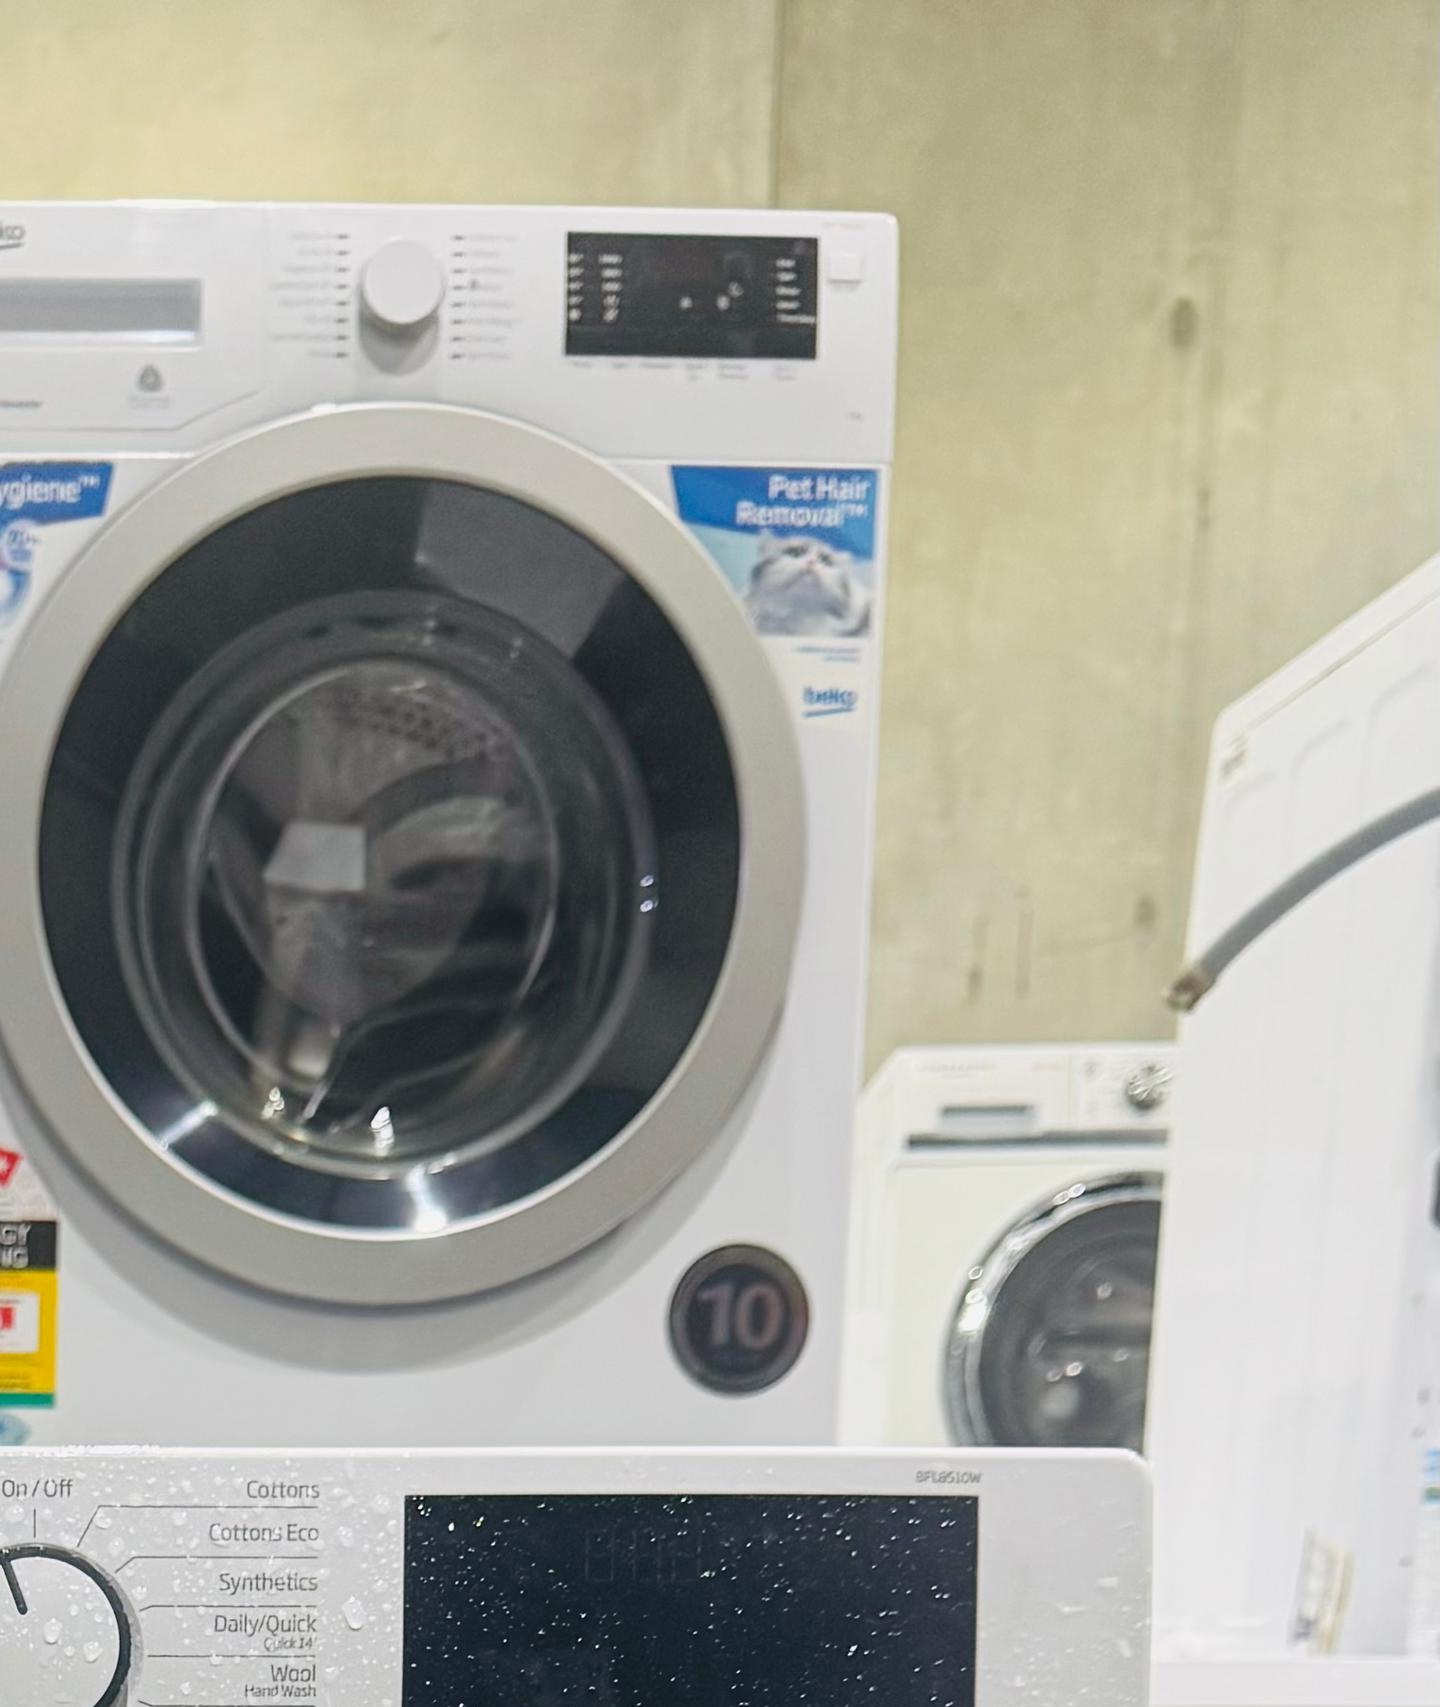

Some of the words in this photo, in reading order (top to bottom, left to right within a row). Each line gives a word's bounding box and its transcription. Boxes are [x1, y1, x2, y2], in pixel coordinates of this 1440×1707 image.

[768, 475, 814, 500] Pet
[816, 476, 871, 500] Hair
[803, 688, 859, 707] beko
[697, 1282, 782, 1348] 10
[1, 1479, 28, 1498] On
[43, 1479, 74, 1498] Off
[246, 1480, 321, 1500] Cottons
[209, 1523, 283, 1542] Cottons
[286, 1524, 319, 1542] Eco
[219, 1572, 318, 1596] Synthetics
[214, 1613, 318, 1637] Daily/Quick
[271, 1664, 317, 1682] Wool
[244, 1684, 279, 1697] Hand
[281, 1684, 317, 1698] Wash
